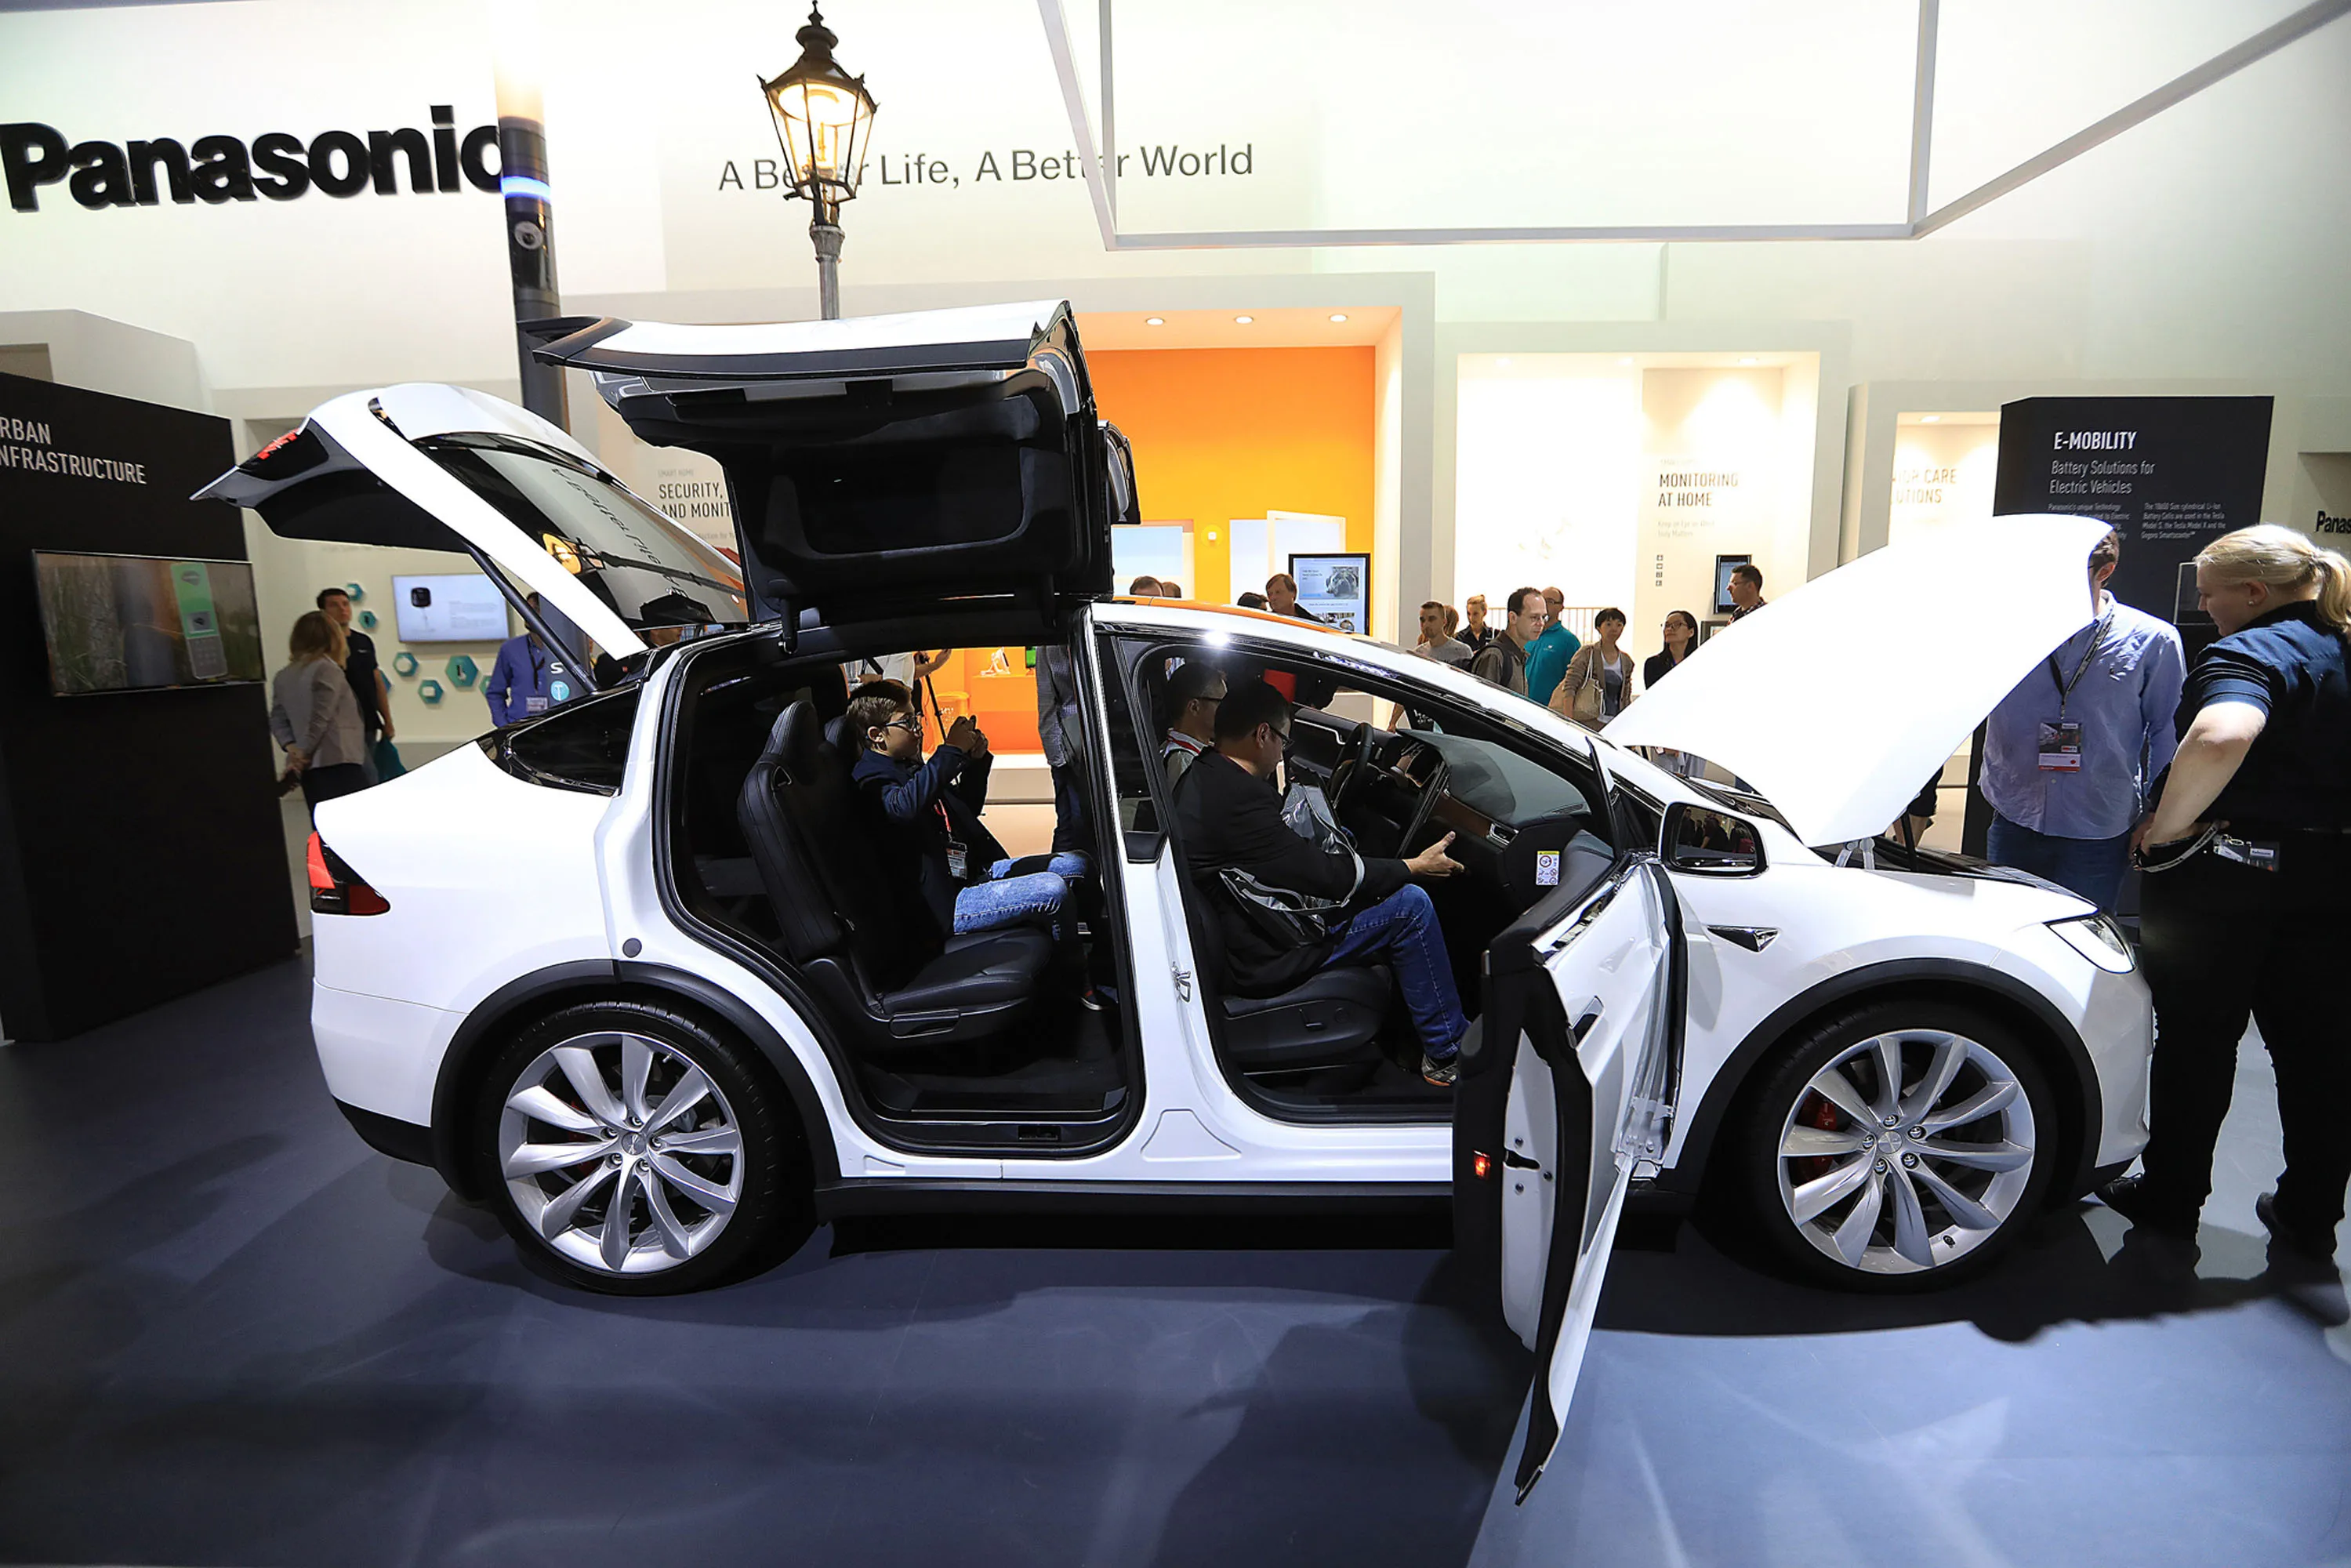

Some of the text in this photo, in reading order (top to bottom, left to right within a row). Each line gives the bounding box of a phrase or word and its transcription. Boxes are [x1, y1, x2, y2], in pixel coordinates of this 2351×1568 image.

[719, 161, 744, 191] A
[881, 154, 959, 188] Life,
[975, 151, 1002, 182] A
[1140, 143, 1253, 176] World
[2053, 431, 2138, 450] E-MOBILITY
[1924, 468, 1957, 484] CARE
[2051, 459, 2156, 478] Battery Solutions for
[1659, 472, 1739, 488] MONITORING
[2049, 479, 2132, 495] Electric Vehicles
[1658, 492, 1713, 507] AT HOME
